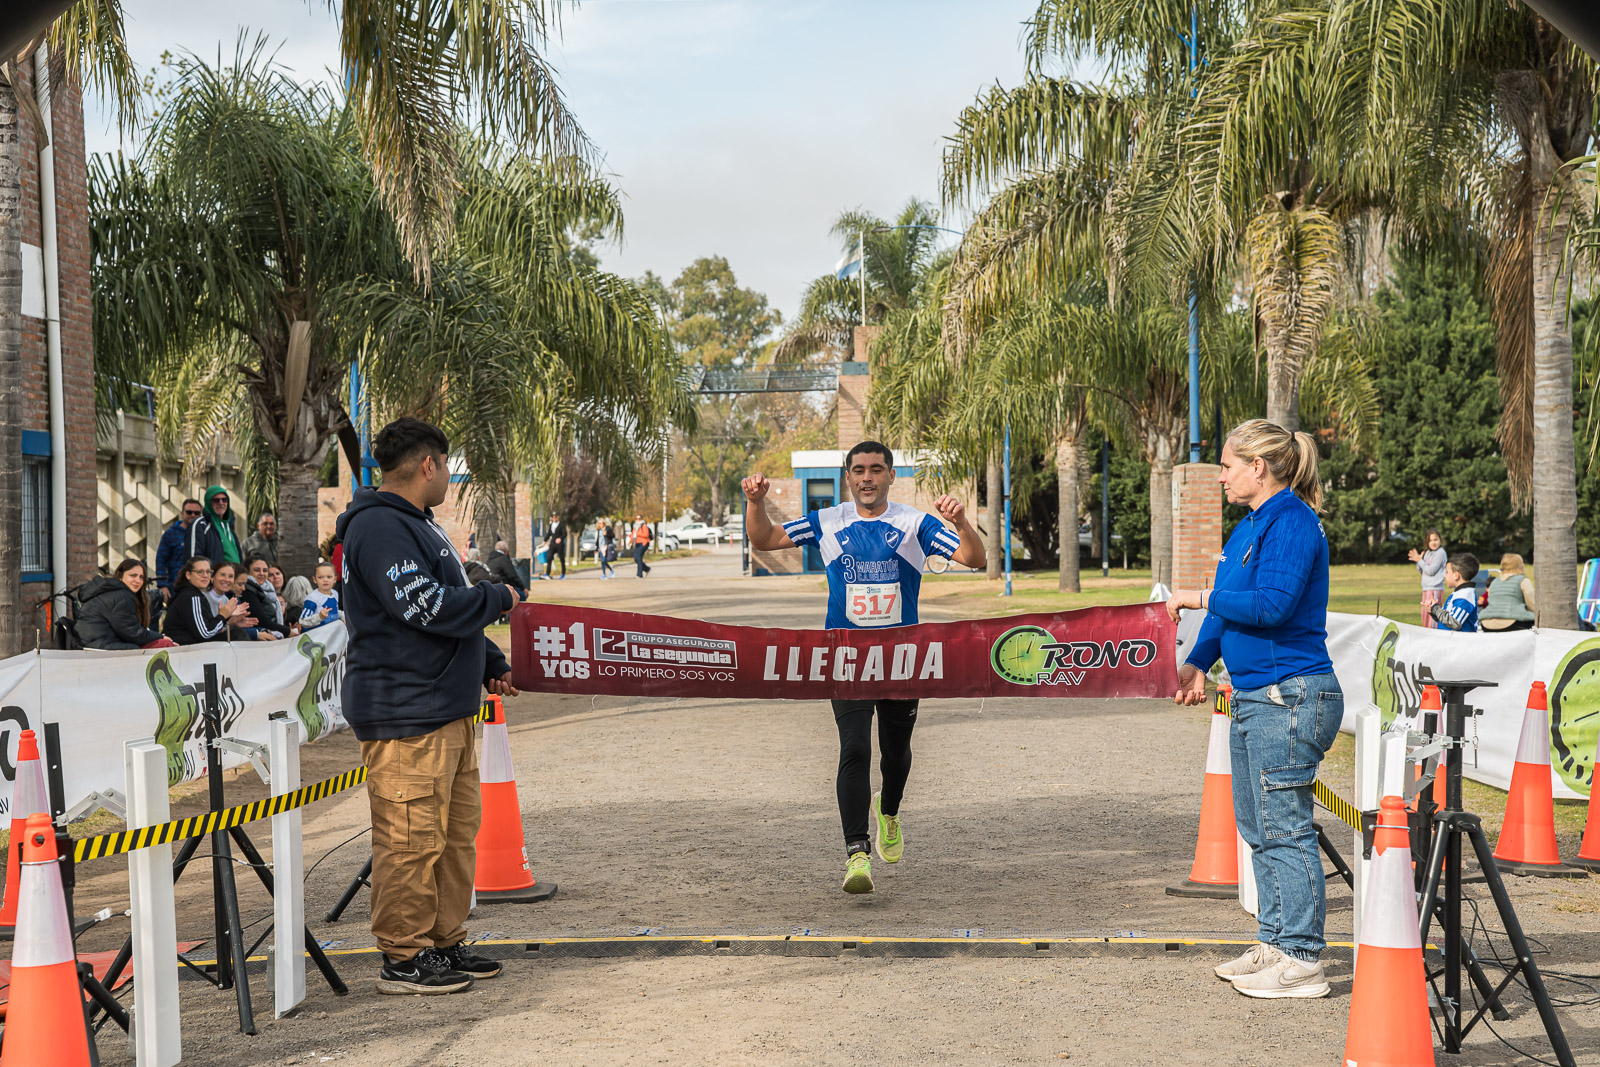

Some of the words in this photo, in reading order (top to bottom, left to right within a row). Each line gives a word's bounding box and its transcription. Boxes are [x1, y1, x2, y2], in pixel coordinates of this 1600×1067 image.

[386, 563, 400, 582] El
[841, 554, 857, 583] 3
[856, 558, 899, 573] MARATÓN
[395, 586, 404, 600] de
[403, 575, 430, 600] pueblo
[853, 594, 897, 615] 517
[533, 622, 589, 659] #1
[631, 634, 664, 644] GRUPO
[665, 637, 731, 650] ASEGURADOR
[631, 645, 651, 658] La
[653, 649, 732, 664] segunda
[763, 642, 944, 682] LLEGADA
[540, 659, 590, 680] VOS
[598, 665, 616, 676] LO
[620, 667, 676, 680] PRIMERO
[679, 670, 704, 681] SOS
[707, 671, 735, 682] VOS
[1036, 670, 1086, 687] RAV
